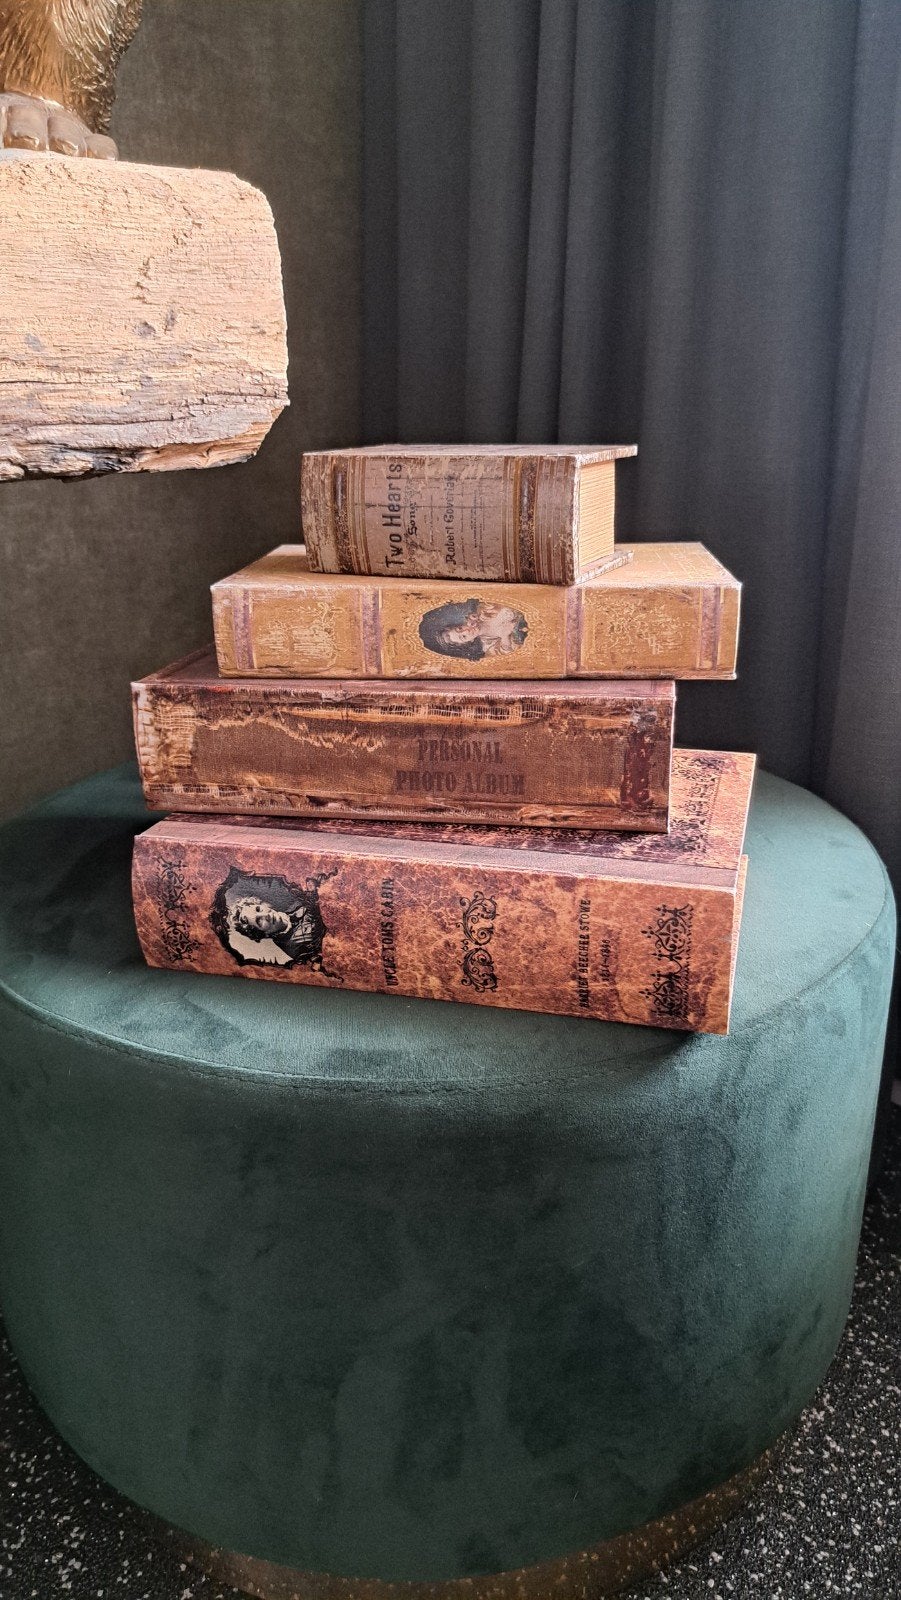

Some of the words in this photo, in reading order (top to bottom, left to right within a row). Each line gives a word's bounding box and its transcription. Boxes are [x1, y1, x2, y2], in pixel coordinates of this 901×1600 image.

[382, 463, 402, 528] Hearts
[385, 533, 404, 568] Two
[443, 527, 456, 566] Robert
[417, 738, 503, 764] PERSONAL
[396, 769, 457, 793] PHOTO
[464, 771, 526, 796] ALBUM
[380, 878, 395, 918] CABIN
[579, 899, 591, 931] STOWE
[381, 921, 395, 954] TOMS
[578, 933, 590, 974] BEECHER
[383, 955, 399, 986] UNCLE
[578, 975, 590, 1009] HARRIET
